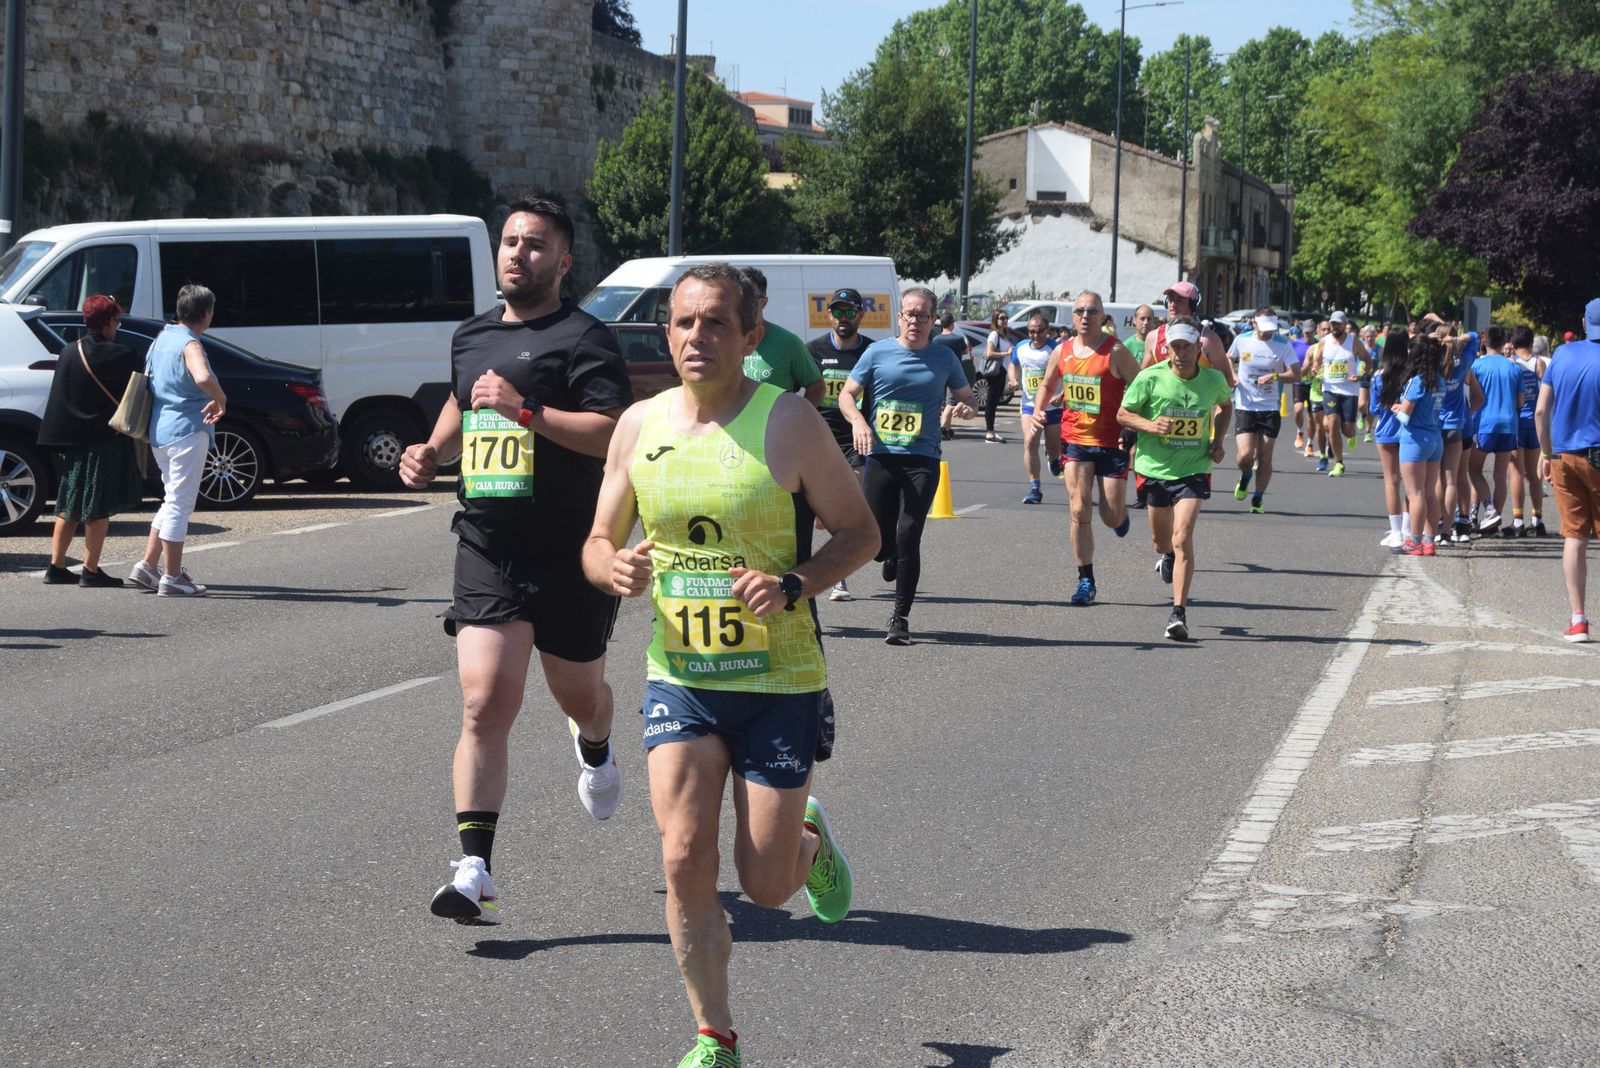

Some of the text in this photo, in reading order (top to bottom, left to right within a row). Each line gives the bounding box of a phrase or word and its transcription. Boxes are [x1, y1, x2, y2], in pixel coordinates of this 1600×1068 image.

[827, 381, 846, 396] 19
[1068, 385, 1095, 401] 106
[478, 421, 496, 429] CAJA
[881, 413, 916, 432] 228
[469, 435, 520, 470] 170
[475, 480, 528, 490] CAJA RURAL
[671, 552, 747, 571] Adarsa
[686, 587, 710, 597] CAJA
[675, 605, 745, 648] 115
[688, 658, 763, 673] CAJA RURAL
